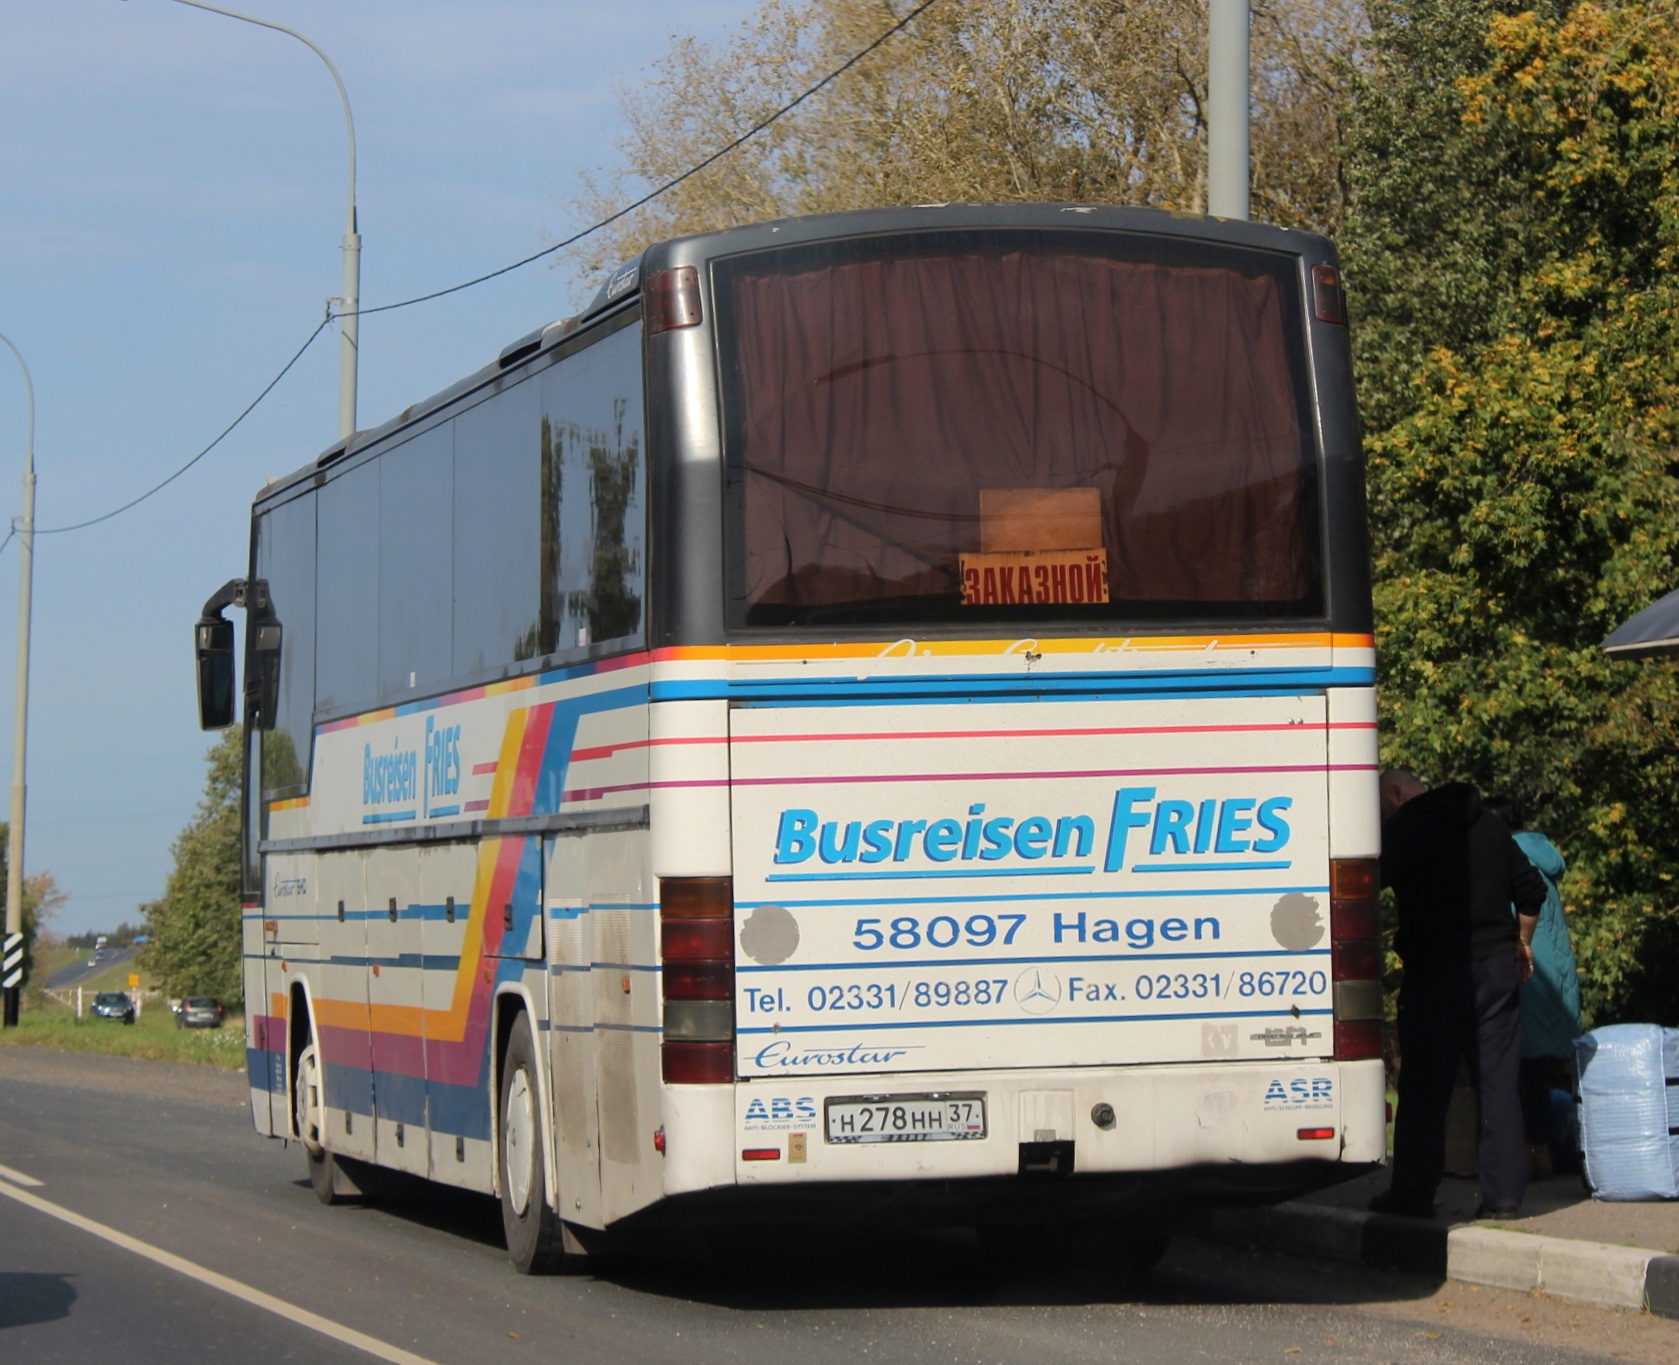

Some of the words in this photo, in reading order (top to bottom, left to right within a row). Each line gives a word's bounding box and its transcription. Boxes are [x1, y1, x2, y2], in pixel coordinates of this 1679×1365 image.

[965, 555, 1103, 604] ЗАКАЗНОЙ
[363, 735, 416, 805] Busreisen
[423, 714, 461, 819] FRIES
[773, 803, 1096, 865] Busreisen
[1104, 787, 1293, 873] FRIES
[852, 914, 1027, 950] 58097
[1053, 912, 1220, 949] Hagen
[743, 987, 791, 1013] Tel.
[807, 979, 1009, 1011] 02331/89887
[1068, 977, 1126, 1001] Fax.
[1135, 970, 1327, 1000] 02331/86720
[743, 1040, 927, 1068] Eurostar
[1264, 1077, 1333, 1104] ASR
[744, 1096, 816, 1123] ABS
[949, 1104, 973, 1122] 37
